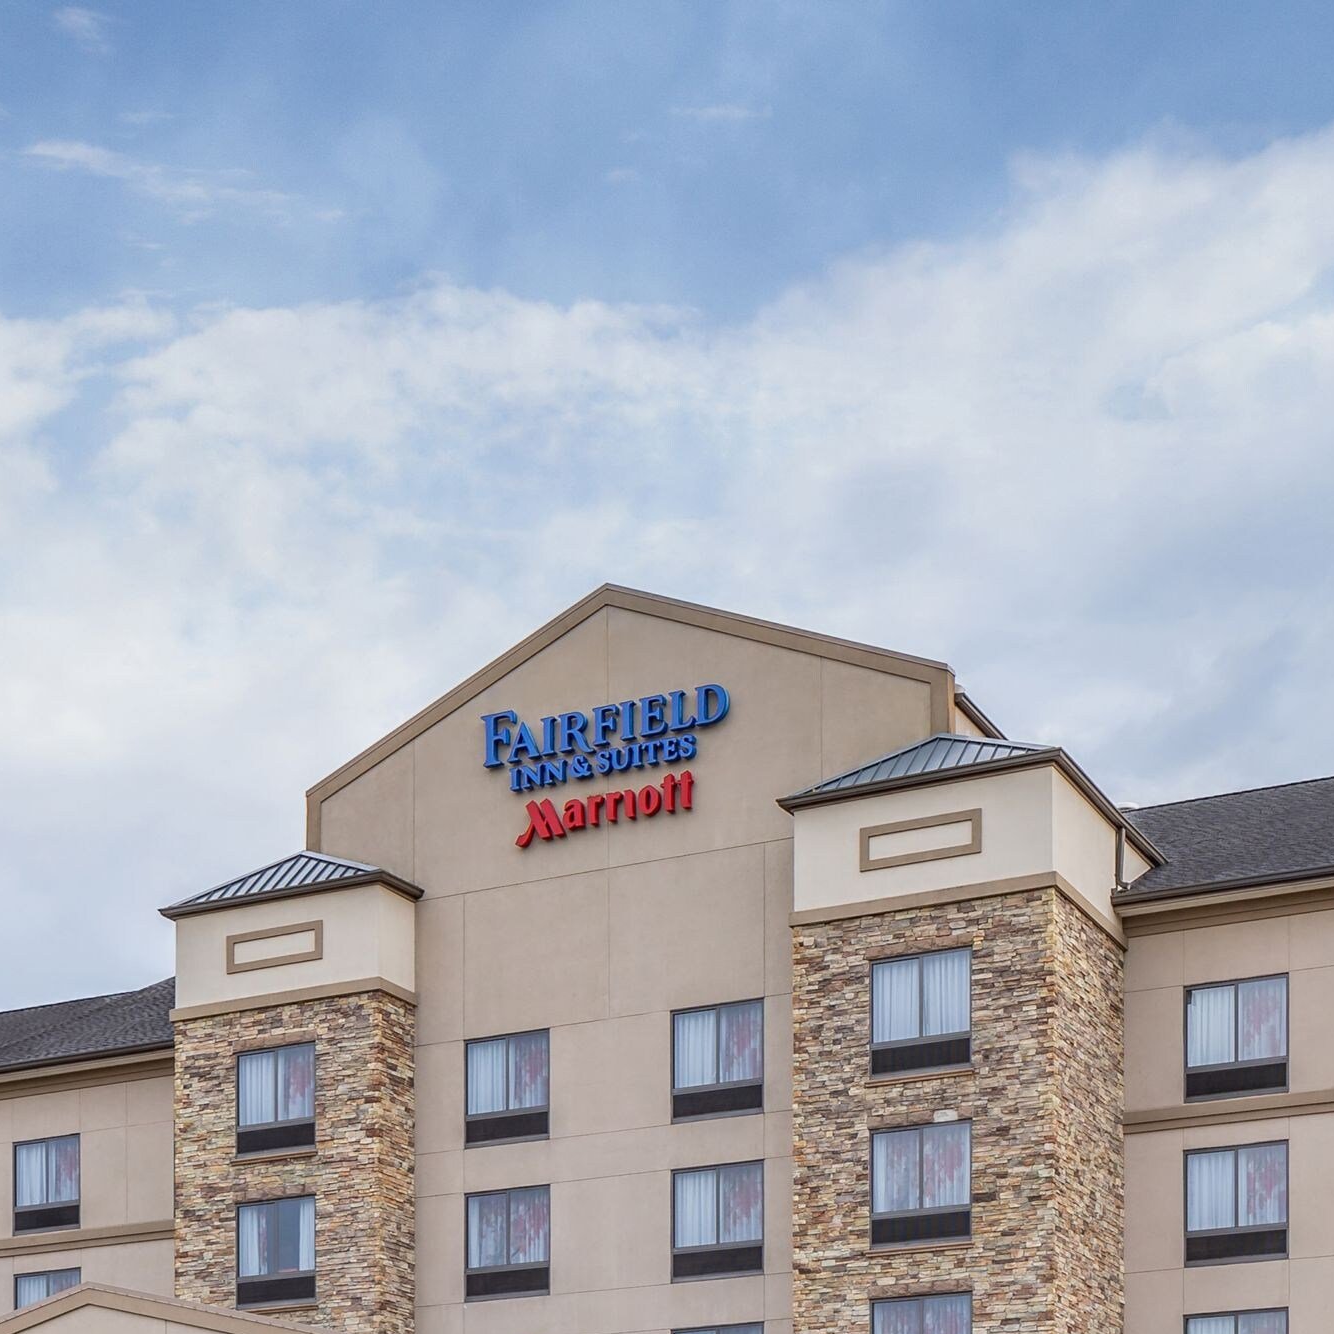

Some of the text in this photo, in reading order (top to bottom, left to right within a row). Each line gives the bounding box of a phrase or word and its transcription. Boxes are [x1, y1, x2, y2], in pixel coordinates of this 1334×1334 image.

[480, 683, 730, 769] FAIRFIELD
[508, 733, 698, 792] INN & SUITES
[515, 769, 695, 848] Marriott
